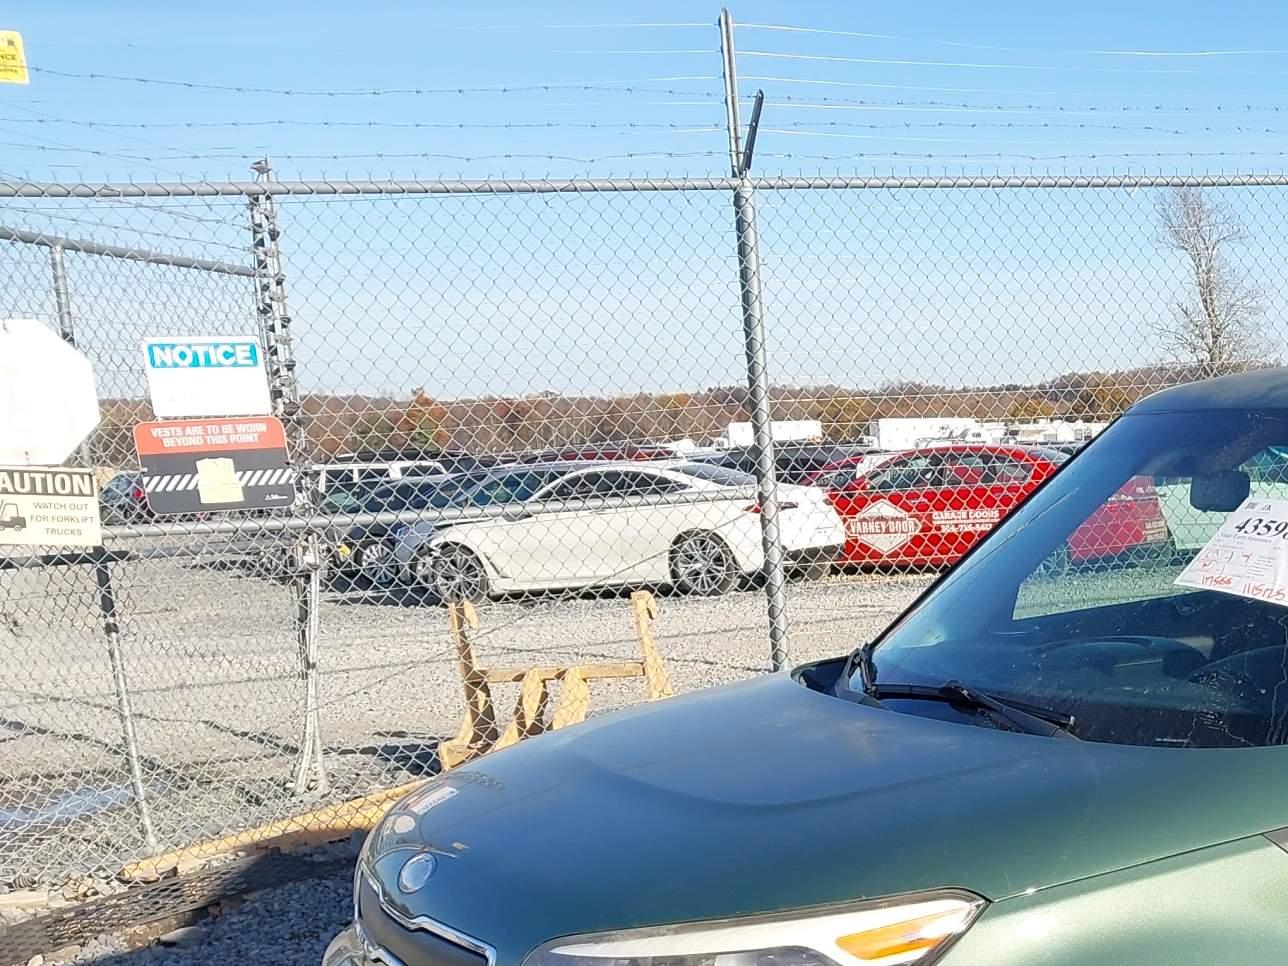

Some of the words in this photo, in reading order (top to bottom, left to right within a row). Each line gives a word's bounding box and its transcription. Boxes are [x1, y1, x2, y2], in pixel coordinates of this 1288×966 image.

[152, 345, 254, 366] NOTICE
[151, 427, 183, 437] VESTS
[185, 426, 204, 436] ARE
[207, 425, 220, 435] TO
[222, 424, 236, 434] BE
[238, 423, 267, 433] WORN
[163, 437, 204, 447] BEYOND
[206, 434, 229, 445] THIS
[231, 433, 258, 443] POINT
[32, 502, 67, 510] WATCH
[69, 503, 89, 511] OUT
[30, 514, 49, 523] FOR
[51, 515, 95, 524] FORKLIFT
[45, 527, 83, 536] TRUCKS
[850, 520, 886, 535] VARNEY
[888, 519, 915, 534] DOOR
